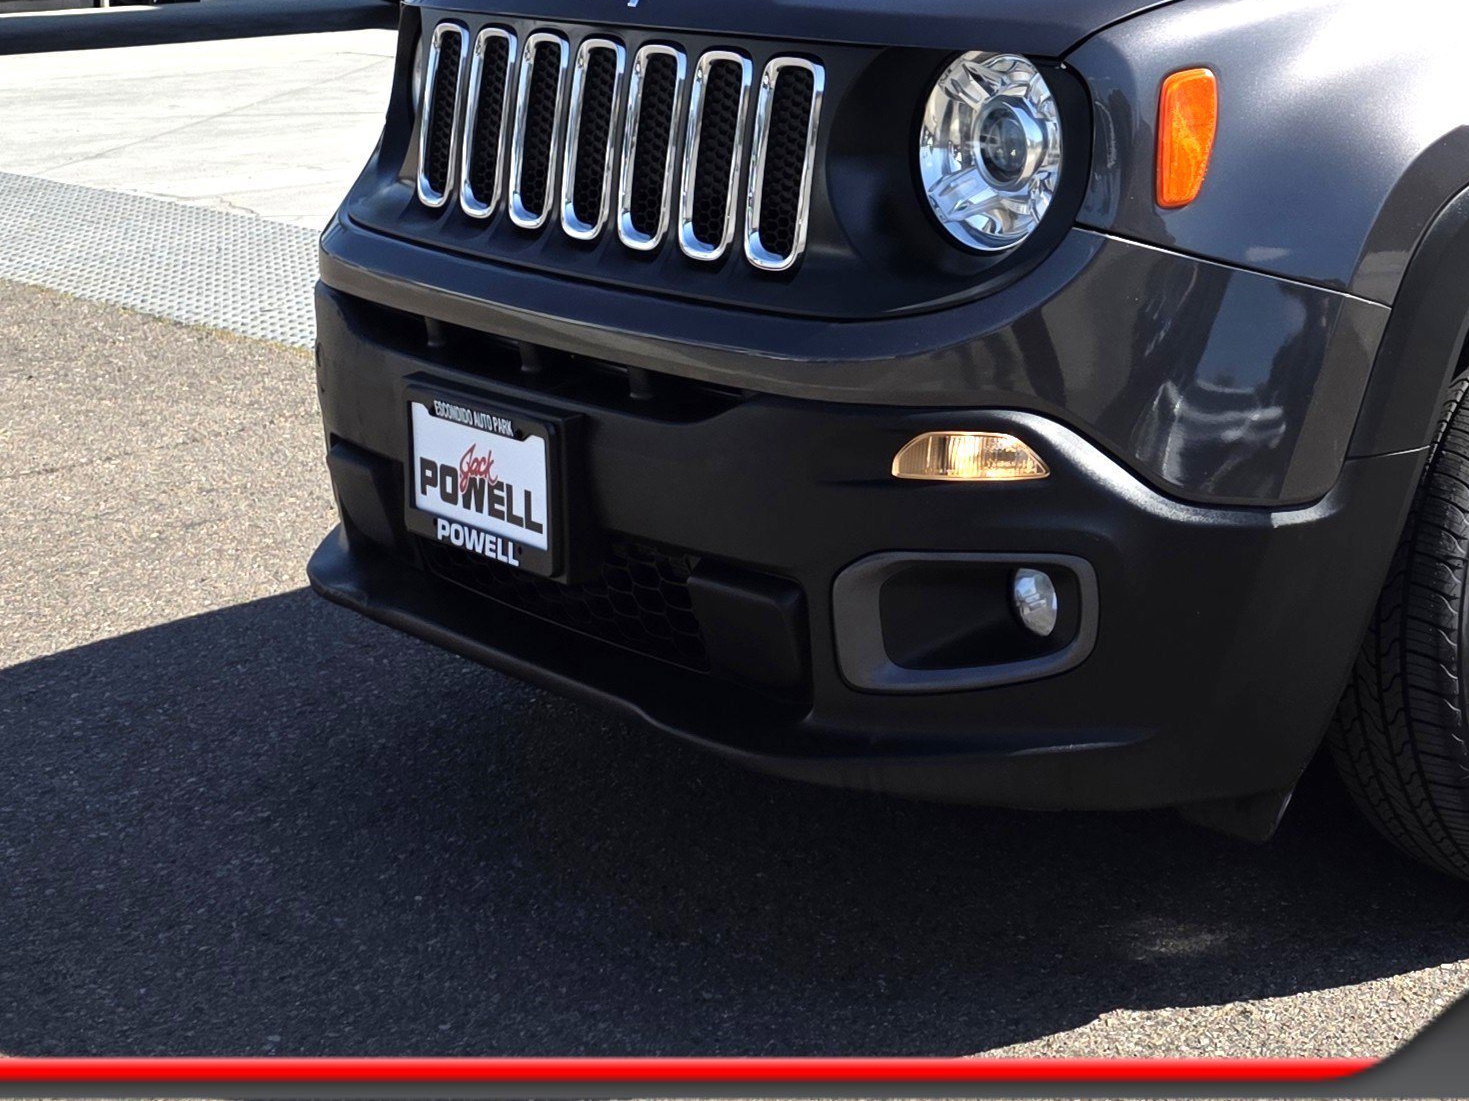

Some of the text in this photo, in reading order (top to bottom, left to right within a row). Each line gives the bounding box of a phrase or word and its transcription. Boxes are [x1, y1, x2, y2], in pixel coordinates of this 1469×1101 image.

[433, 400, 514, 437] ESCONDIDO AUTO PARK
[459, 443, 498, 493] Jack
[419, 456, 543, 535] POWELL
[437, 518, 519, 567] POWELL
